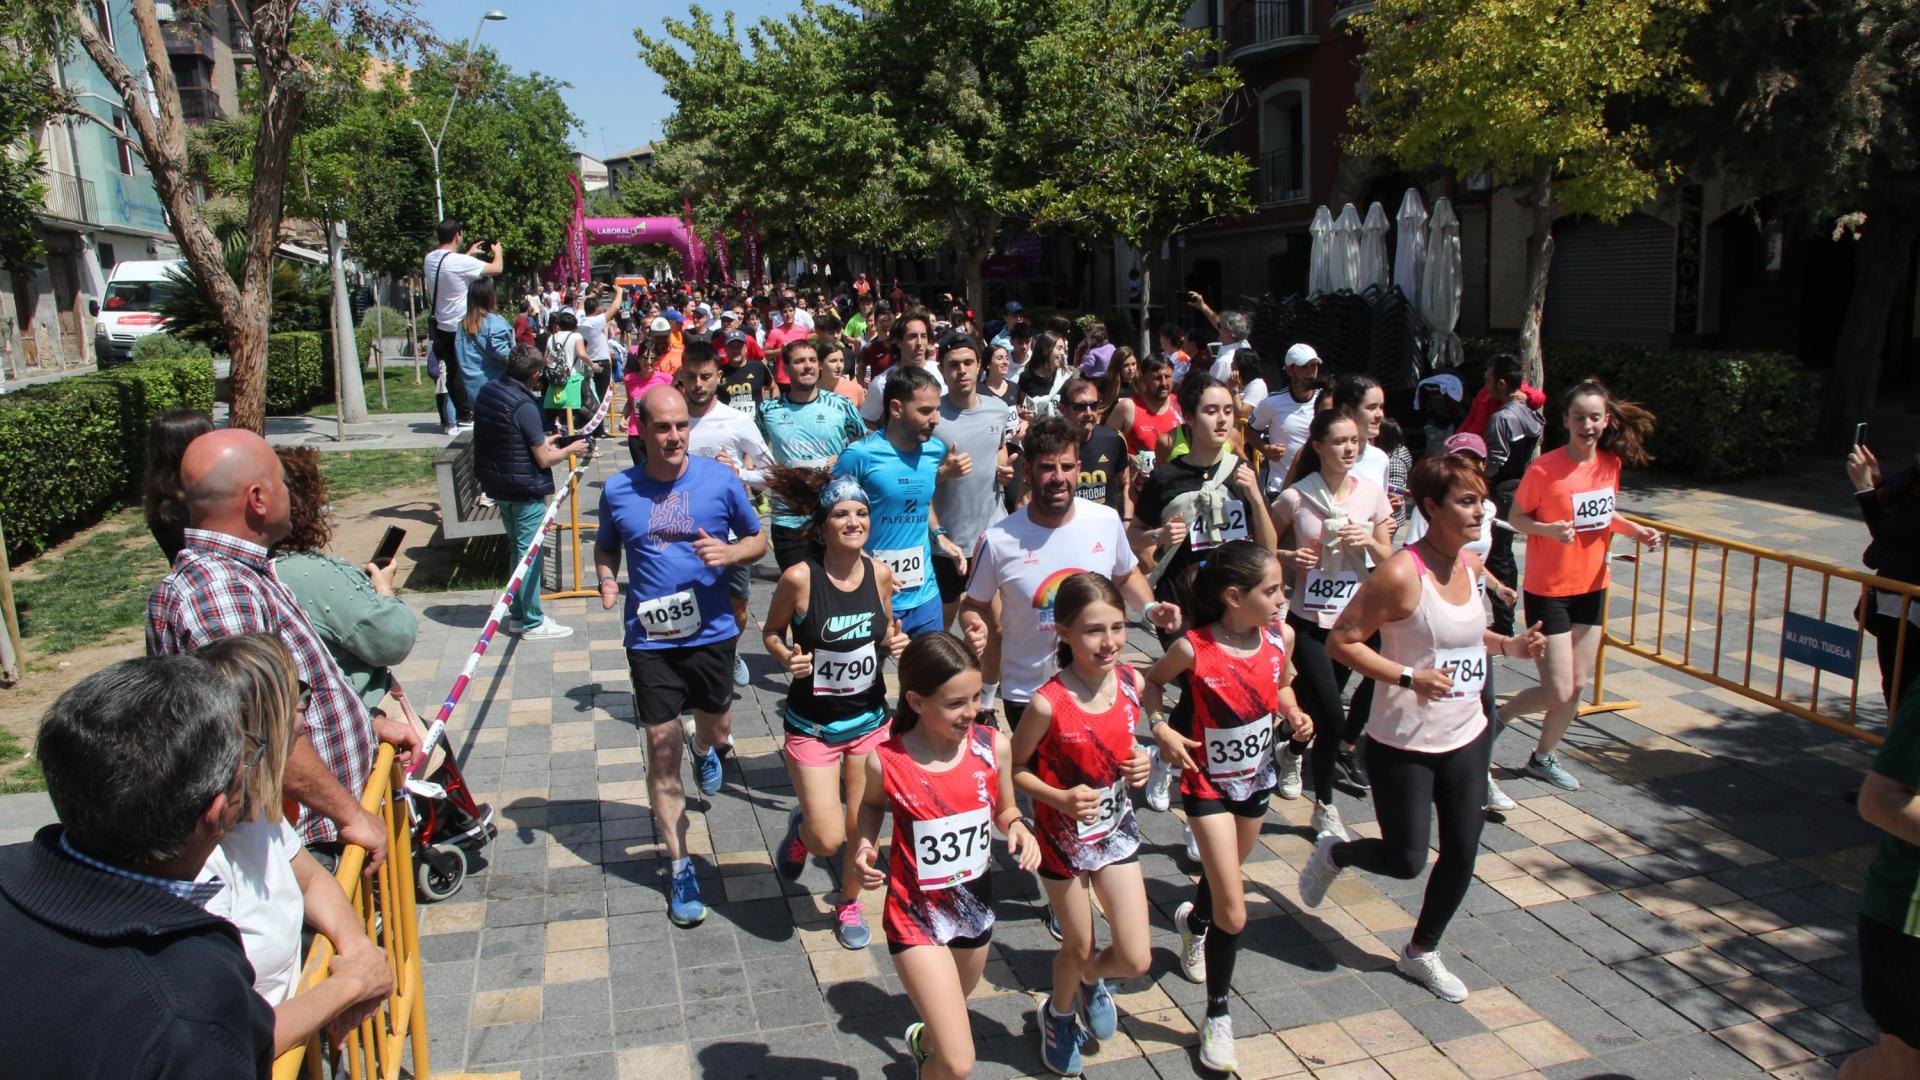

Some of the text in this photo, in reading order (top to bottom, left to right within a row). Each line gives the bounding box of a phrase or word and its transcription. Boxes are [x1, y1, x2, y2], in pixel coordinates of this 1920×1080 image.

[597, 227, 631, 235] LABORAL
[726, 382, 752, 394] 100
[1077, 469, 1107, 485] 00
[1576, 496, 1614, 518] 4823
[1192, 510, 1245, 534] 42
[884, 557, 920, 573] 120
[1308, 579, 1357, 598] 4827
[644, 601, 694, 624] 1035
[828, 612, 873, 641] NIKE
[1821, 641, 1851, 659] TUDELA
[817, 656, 875, 681] 4790
[1209, 727, 1271, 764] 3382
[919, 820, 991, 866] 3375
